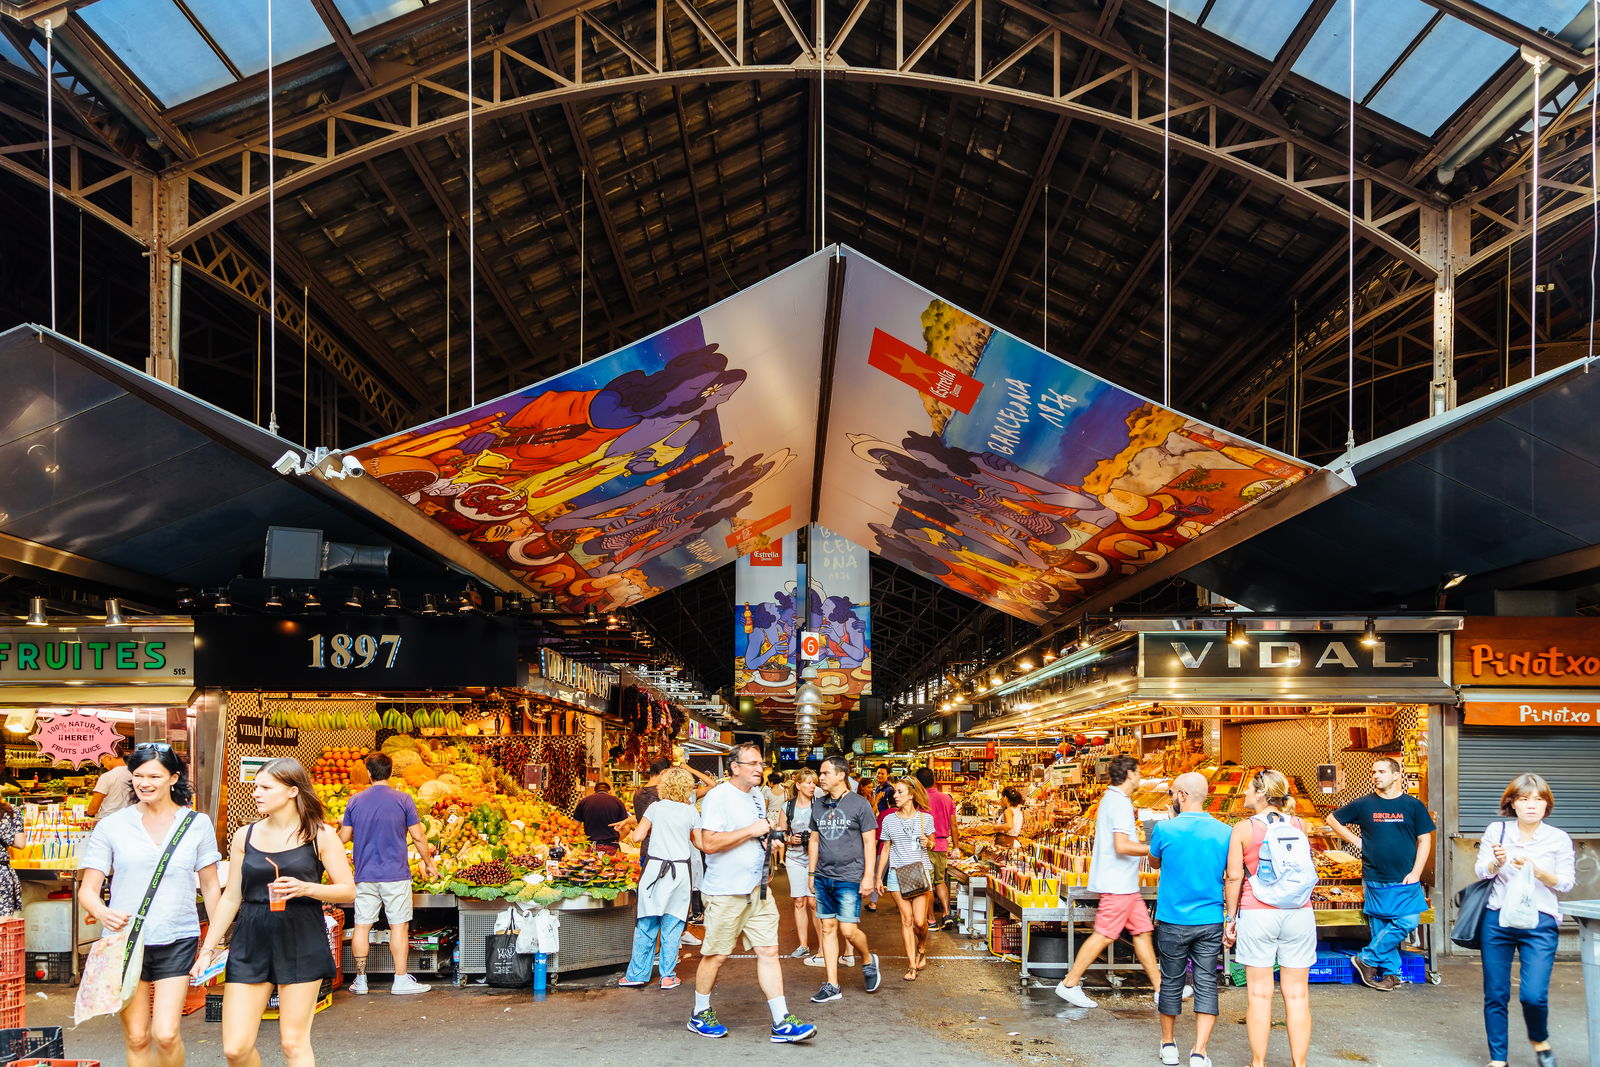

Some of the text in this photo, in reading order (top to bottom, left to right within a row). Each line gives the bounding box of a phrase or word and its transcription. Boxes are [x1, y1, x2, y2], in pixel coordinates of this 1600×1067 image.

[928, 368, 957, 399] Estrella
[1037, 388, 1078, 428] 1876
[987, 377, 1032, 456] BARCELONA
[753, 550, 779, 558] Estrella
[308, 633, 402, 668] 1897
[807, 640, 815, 653] 6
[1170, 640, 1414, 669] VIDAL
[47, 723, 67, 735] 100%
[69, 721, 105, 736] NATURAL
[239, 723, 297, 739] VIDAL PONS 1897
[51, 743, 77, 754] FRUITS
[81, 743, 101, 755] JUICE
[816, 817, 852, 827] imagine
